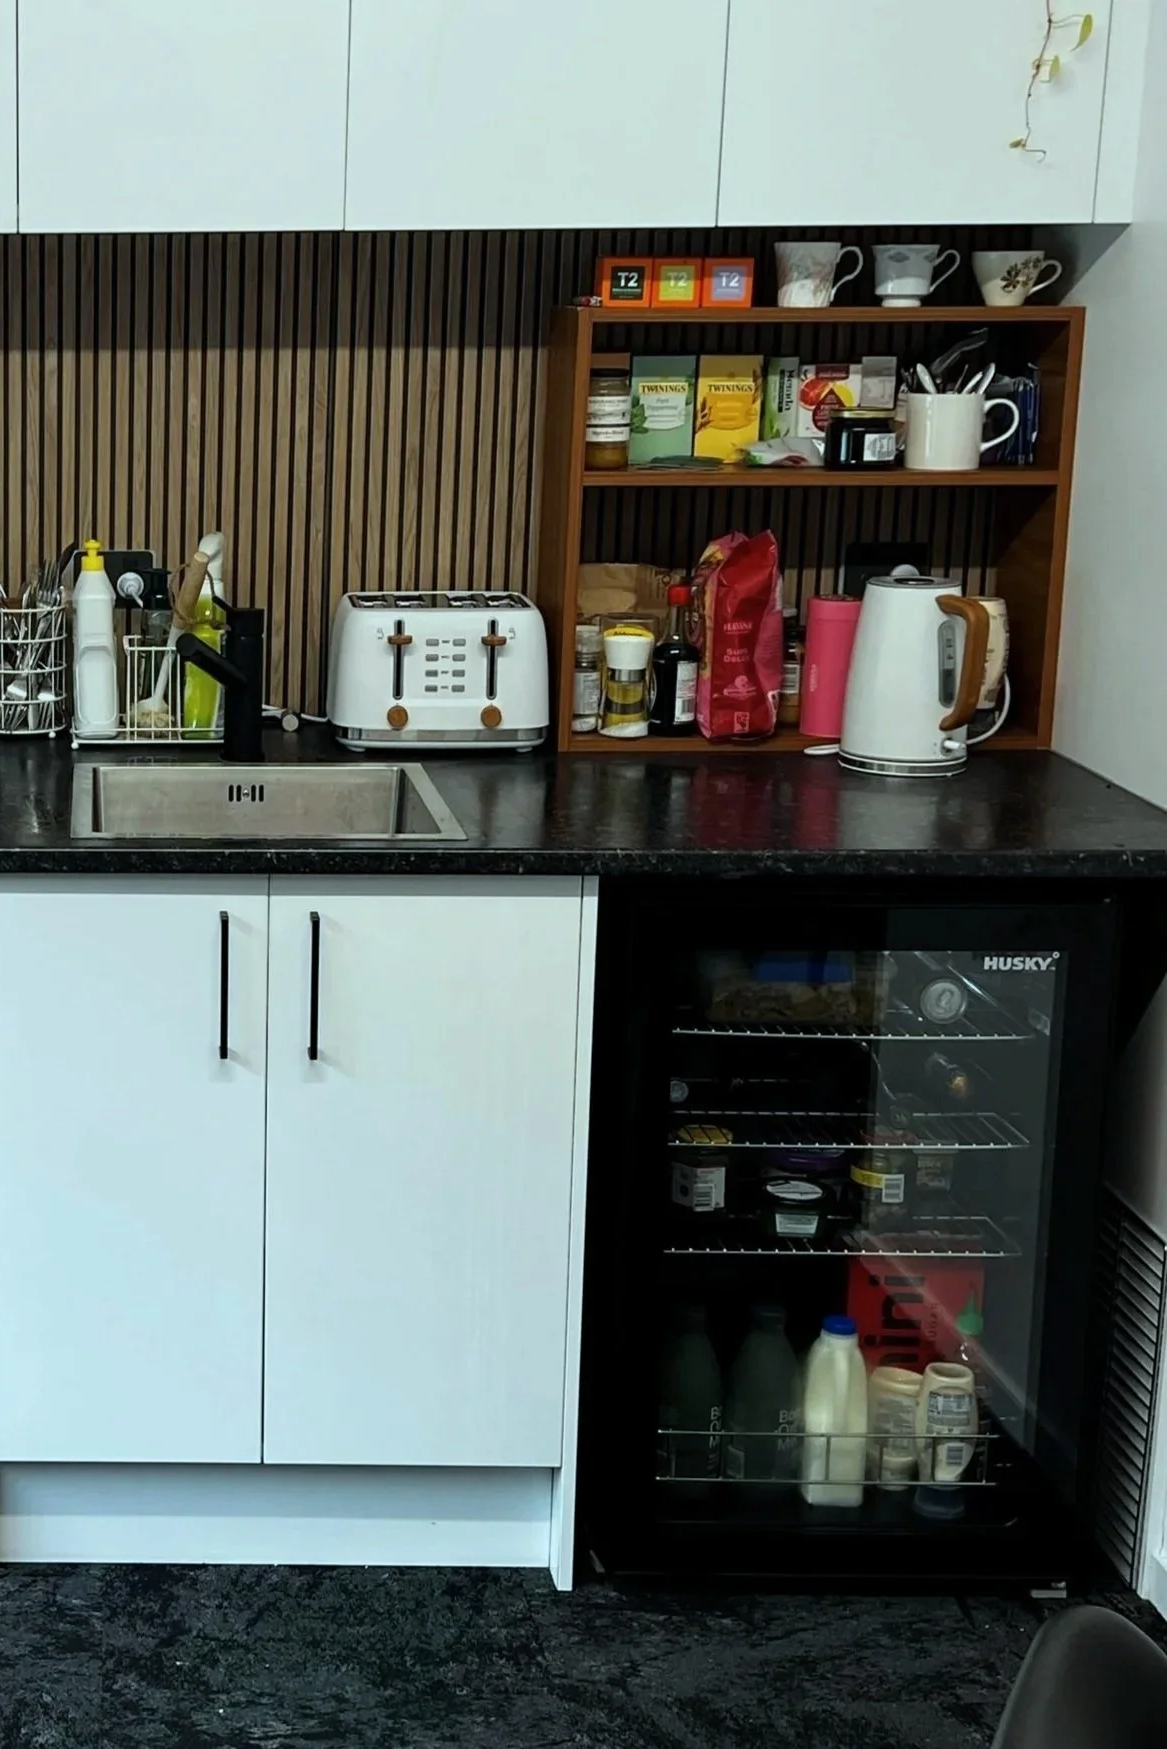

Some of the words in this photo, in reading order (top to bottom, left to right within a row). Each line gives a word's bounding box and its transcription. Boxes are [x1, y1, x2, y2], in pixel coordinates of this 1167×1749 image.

[618, 272, 639, 287] T2
[668, 272, 688, 287] T2
[719, 272, 739, 287] T2
[640, 384, 687, 393] TWININGS
[708, 384, 753, 393] TWININGS
[983, 956, 1053, 971] HUSKY
